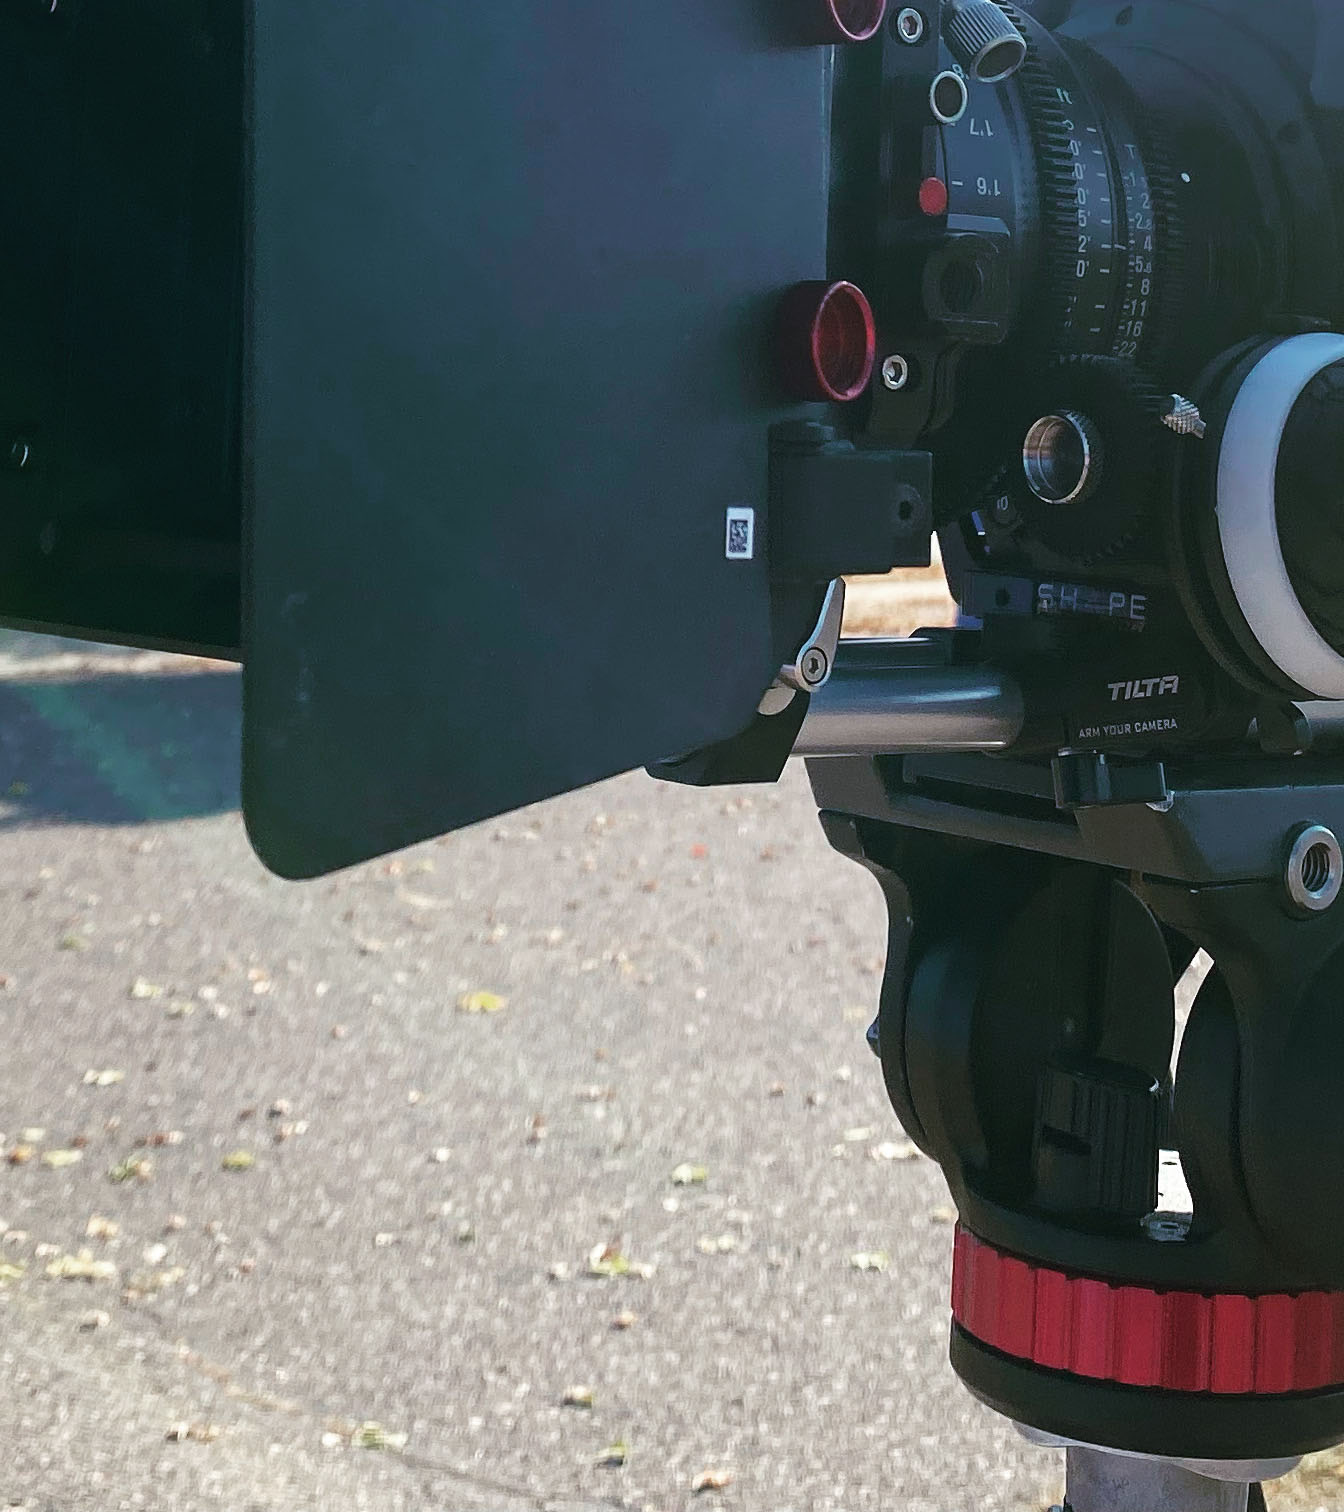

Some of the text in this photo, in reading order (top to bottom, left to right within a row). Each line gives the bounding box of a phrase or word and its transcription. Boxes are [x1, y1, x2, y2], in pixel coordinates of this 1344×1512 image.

[1143, 235, 1153, 252] 4
[1140, 279, 1150, 295] 8
[1107, 675, 1180, 701] TILTA
[1078, 718, 1178, 739] ARM YOUR CAMERA
